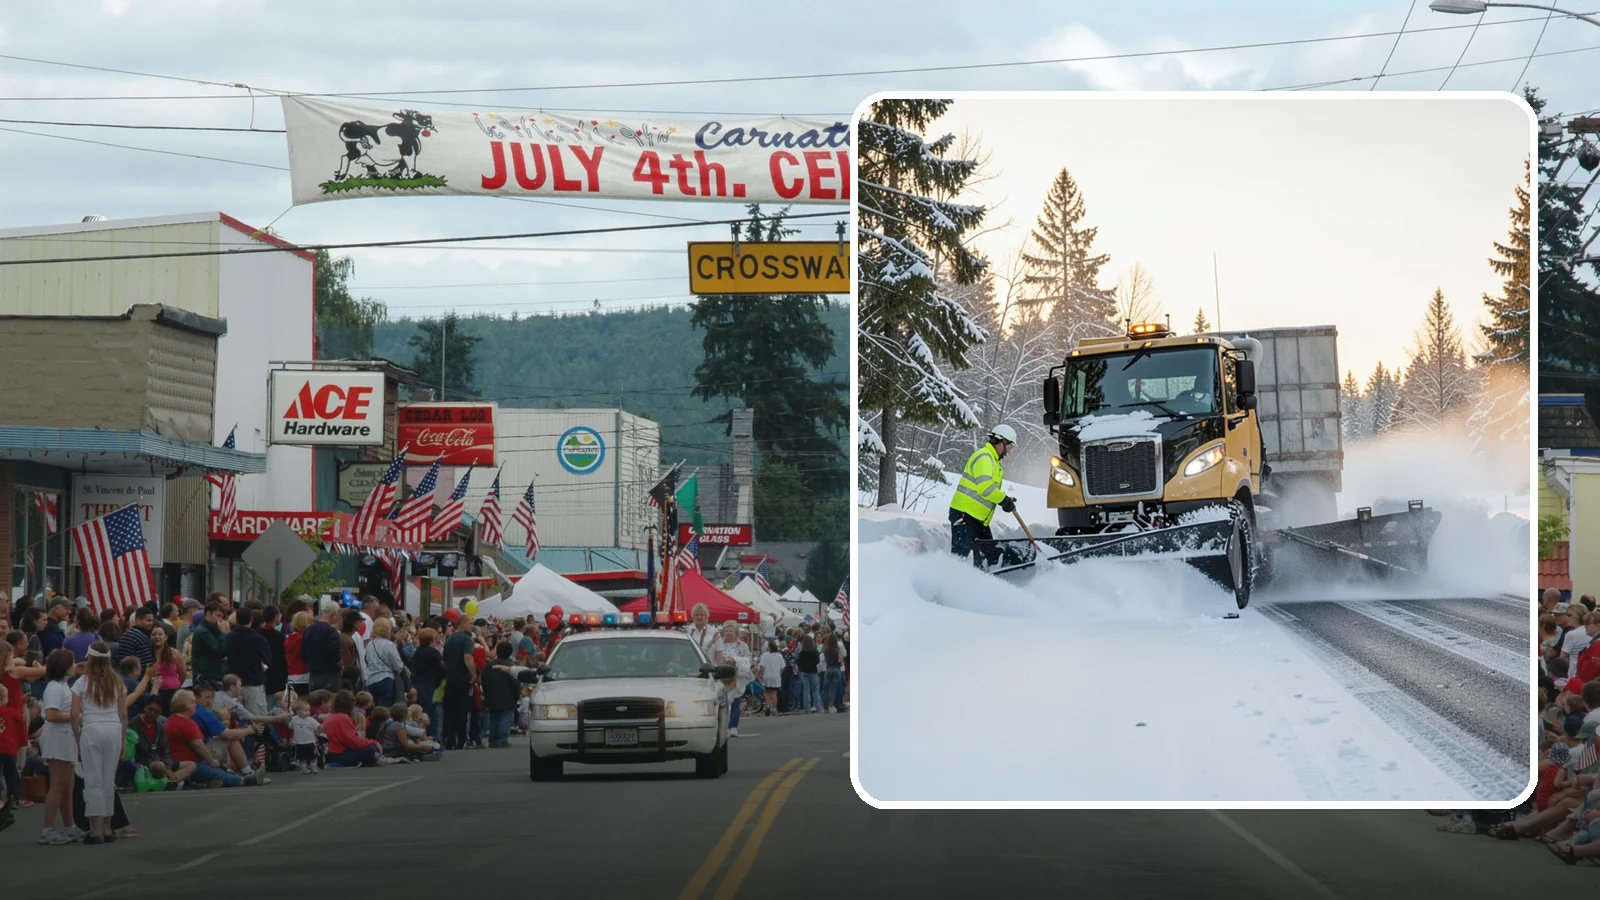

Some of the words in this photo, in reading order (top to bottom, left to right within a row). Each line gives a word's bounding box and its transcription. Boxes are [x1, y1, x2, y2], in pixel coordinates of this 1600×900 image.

[694, 121, 850, 150] Carnat
[481, 141, 605, 192] JULY
[632, 150, 746, 197] 4th.
[696, 254, 850, 280] CROSSWA
[282, 380, 374, 420] ACE
[405, 409, 453, 422] CEDAR
[461, 409, 486, 421] LOG
[283, 420, 371, 436] Hardware
[416, 428, 477, 447] Coca-Cola
[353, 467, 384, 479] Simpl
[95, 485, 124, 494] Vincent
[126, 485, 136, 494] de
[137, 485, 155, 495] Paul
[80, 503, 154, 521] THT
[688, 526, 741, 535] CRNATION
[699, 535, 730, 543] GLASS
